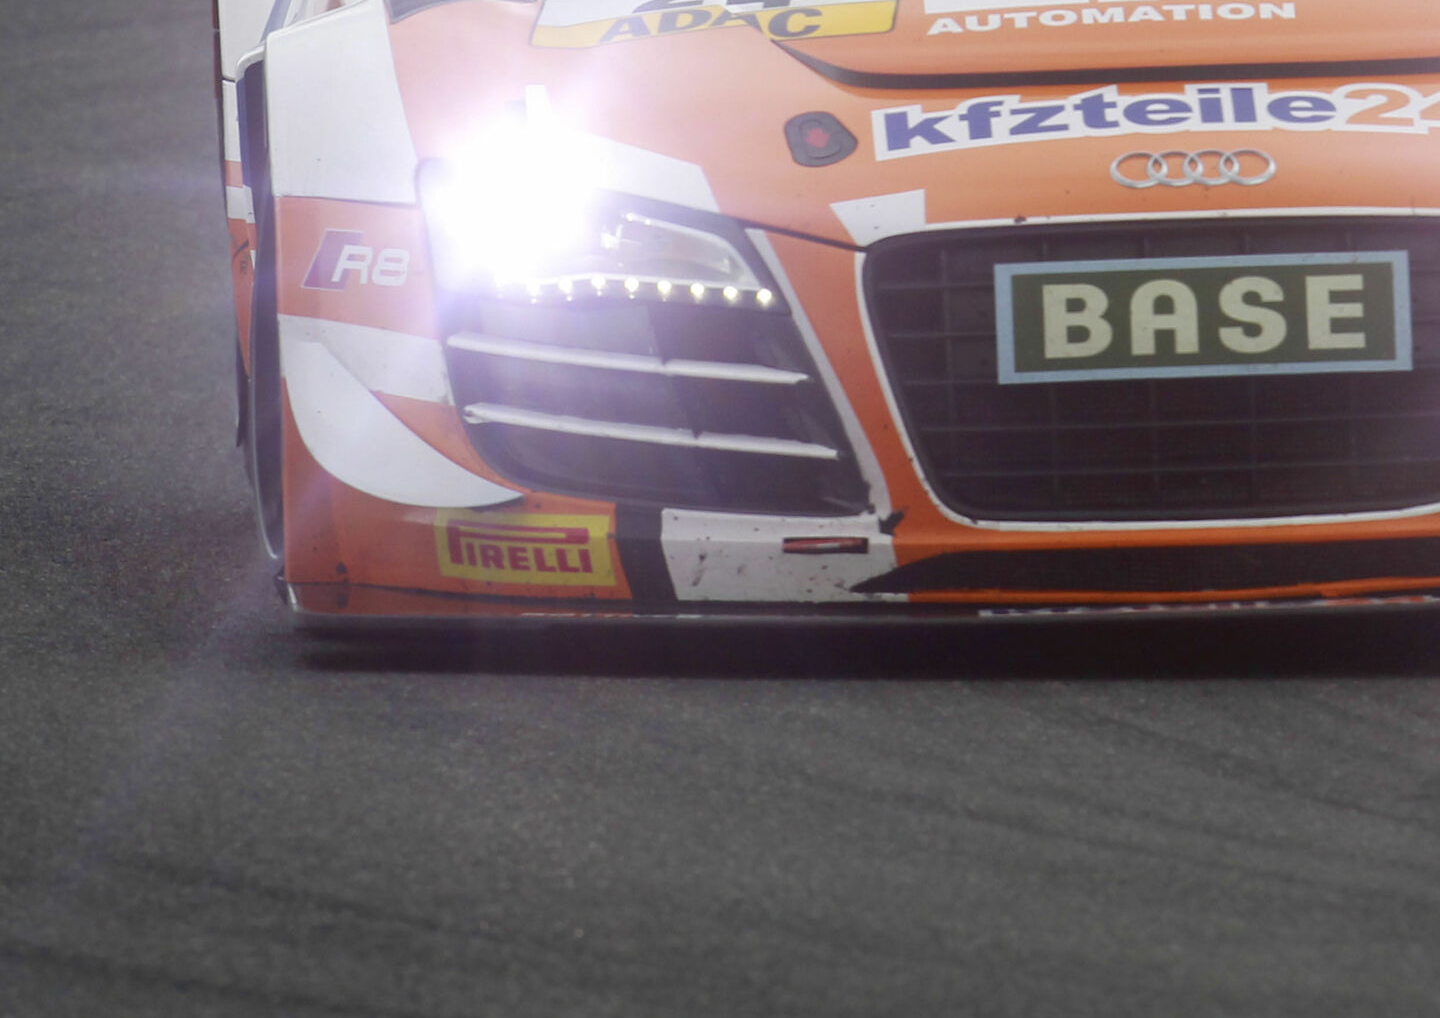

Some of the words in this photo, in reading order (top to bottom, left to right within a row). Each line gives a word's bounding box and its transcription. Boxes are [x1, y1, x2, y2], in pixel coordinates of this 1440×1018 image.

[600, 8, 822, 43] ADAC
[927, 2, 1297, 36] AUTOMATION
[330, 244, 410, 287] R8
[1042, 274, 1368, 361] BASE
[446, 518, 594, 575] PIRELLI
